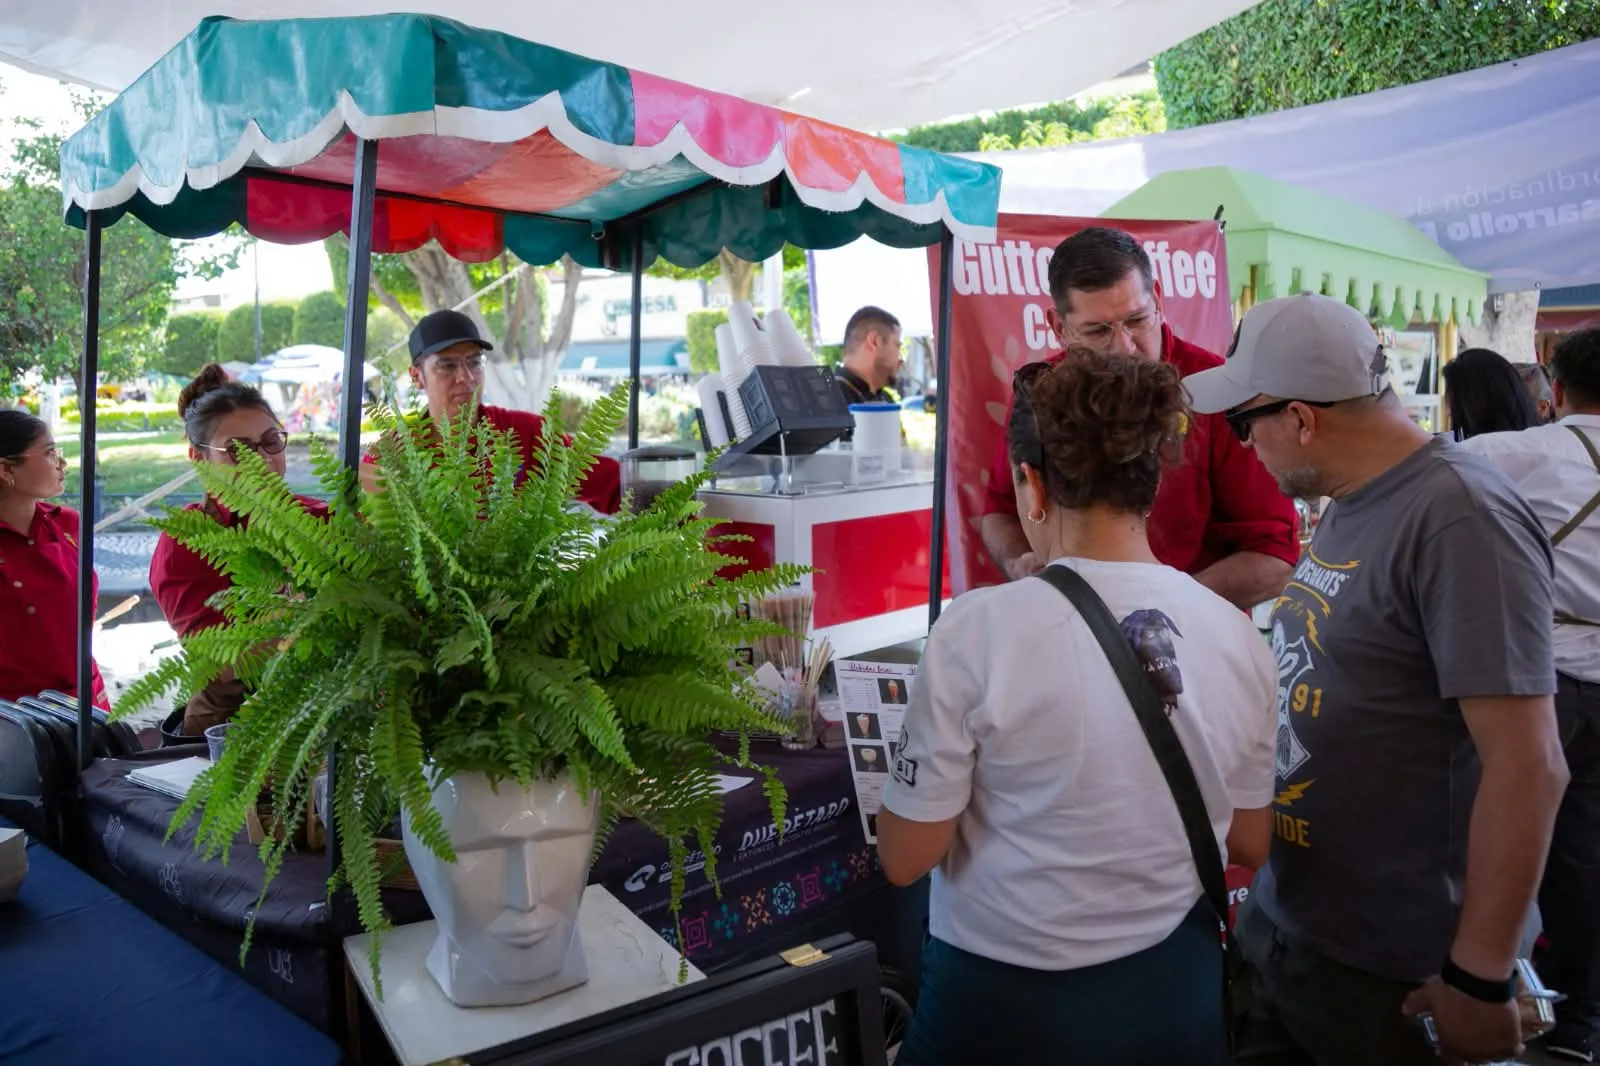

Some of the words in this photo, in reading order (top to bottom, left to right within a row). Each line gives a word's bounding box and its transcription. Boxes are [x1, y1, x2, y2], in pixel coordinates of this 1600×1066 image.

[1144, 240, 1217, 298] ffee
[1293, 683, 1323, 719] 91
[1274, 810, 1311, 848] IDE
